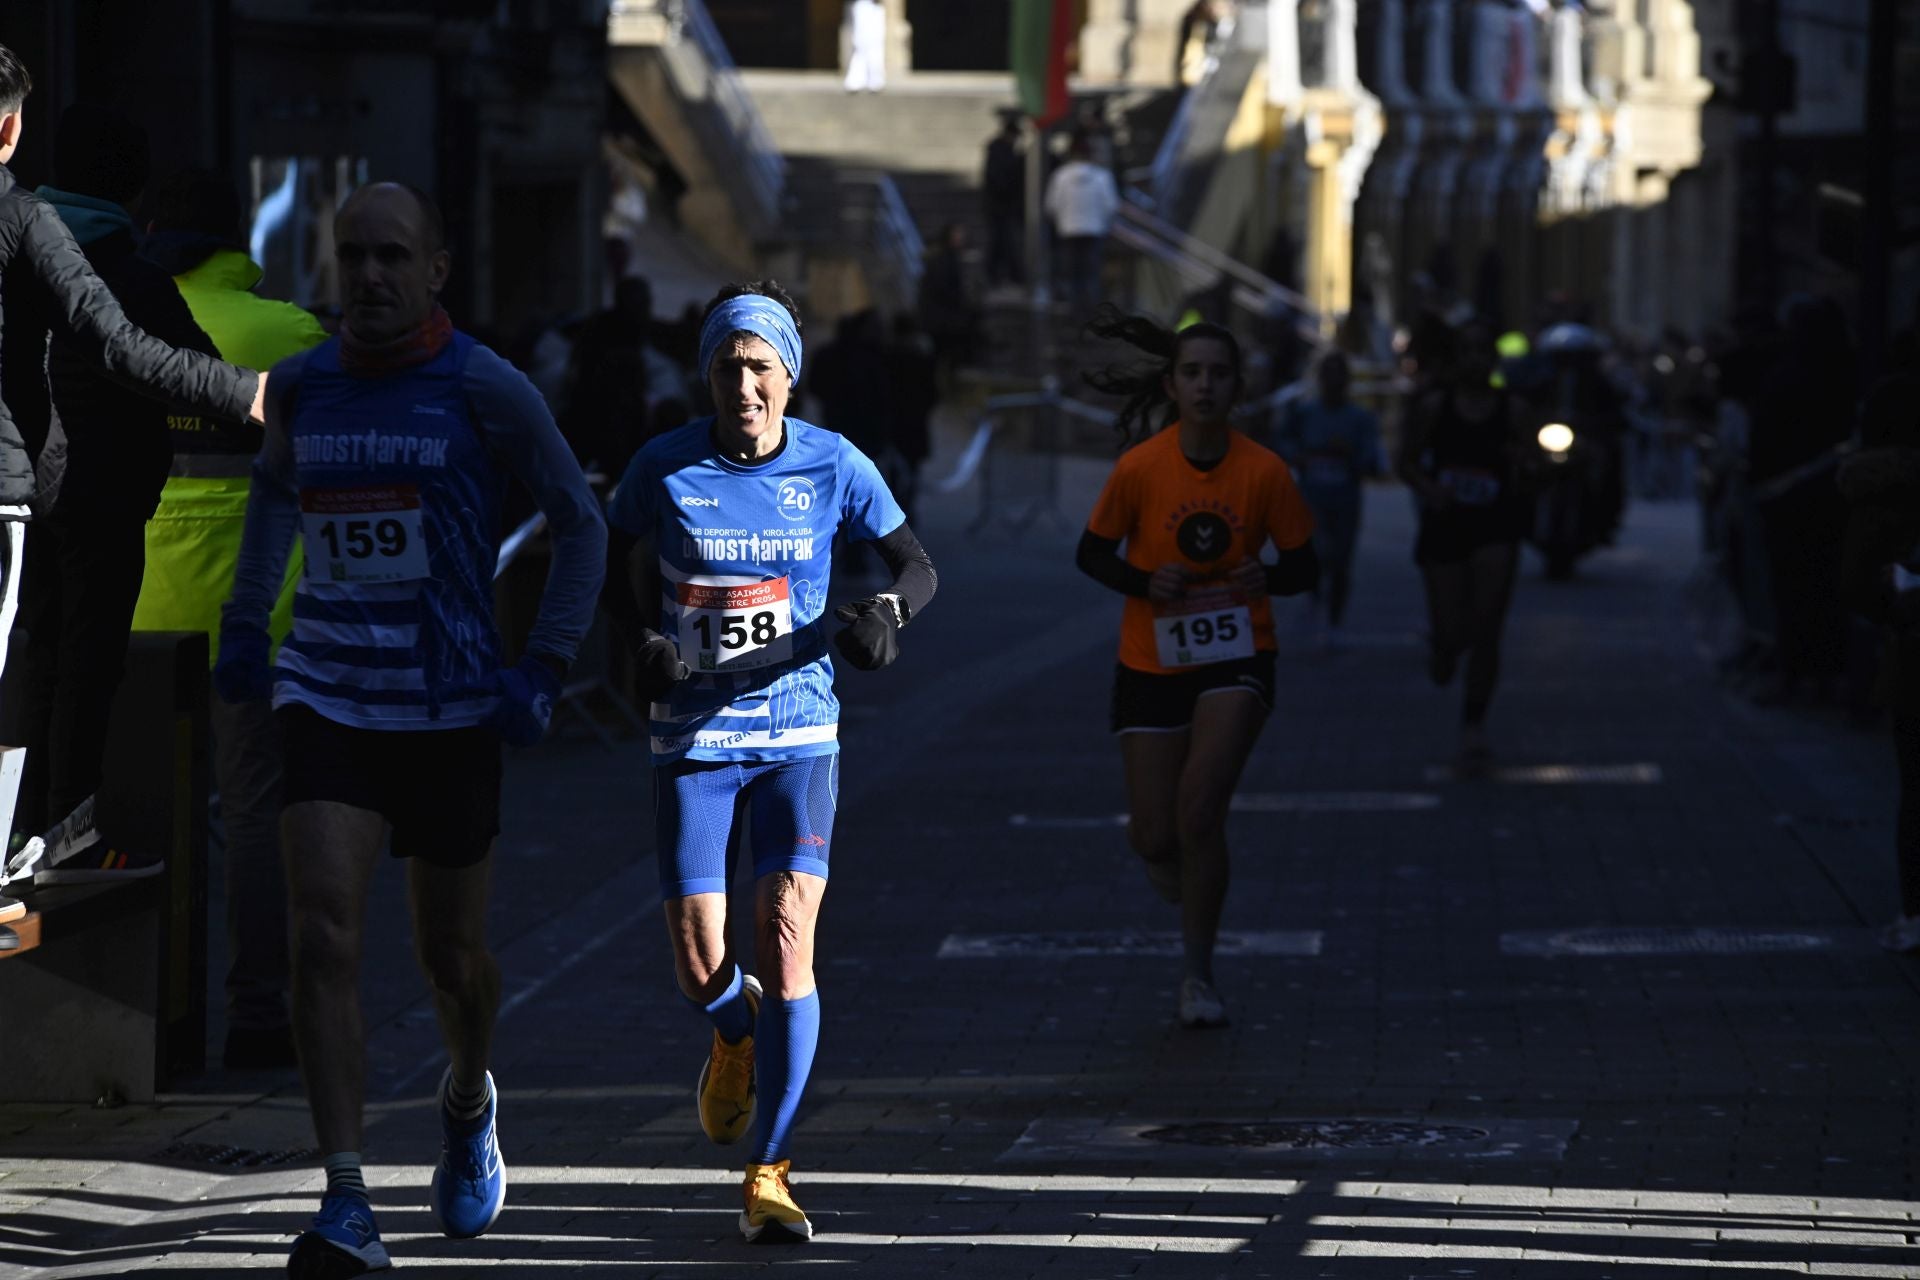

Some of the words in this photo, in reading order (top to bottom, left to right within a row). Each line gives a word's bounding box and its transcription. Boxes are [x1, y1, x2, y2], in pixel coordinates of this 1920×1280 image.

[783, 486, 810, 510] 20
[321, 518, 407, 559] 159
[683, 527, 703, 536] LUB
[704, 528, 748, 537] DEPORTIVO
[763, 528, 813, 537] KIROL-KLUBA
[688, 597, 702, 606] SAN
[751, 594, 777, 605] KROSA
[693, 611, 777, 649] 158
[1169, 614, 1238, 648] 195
